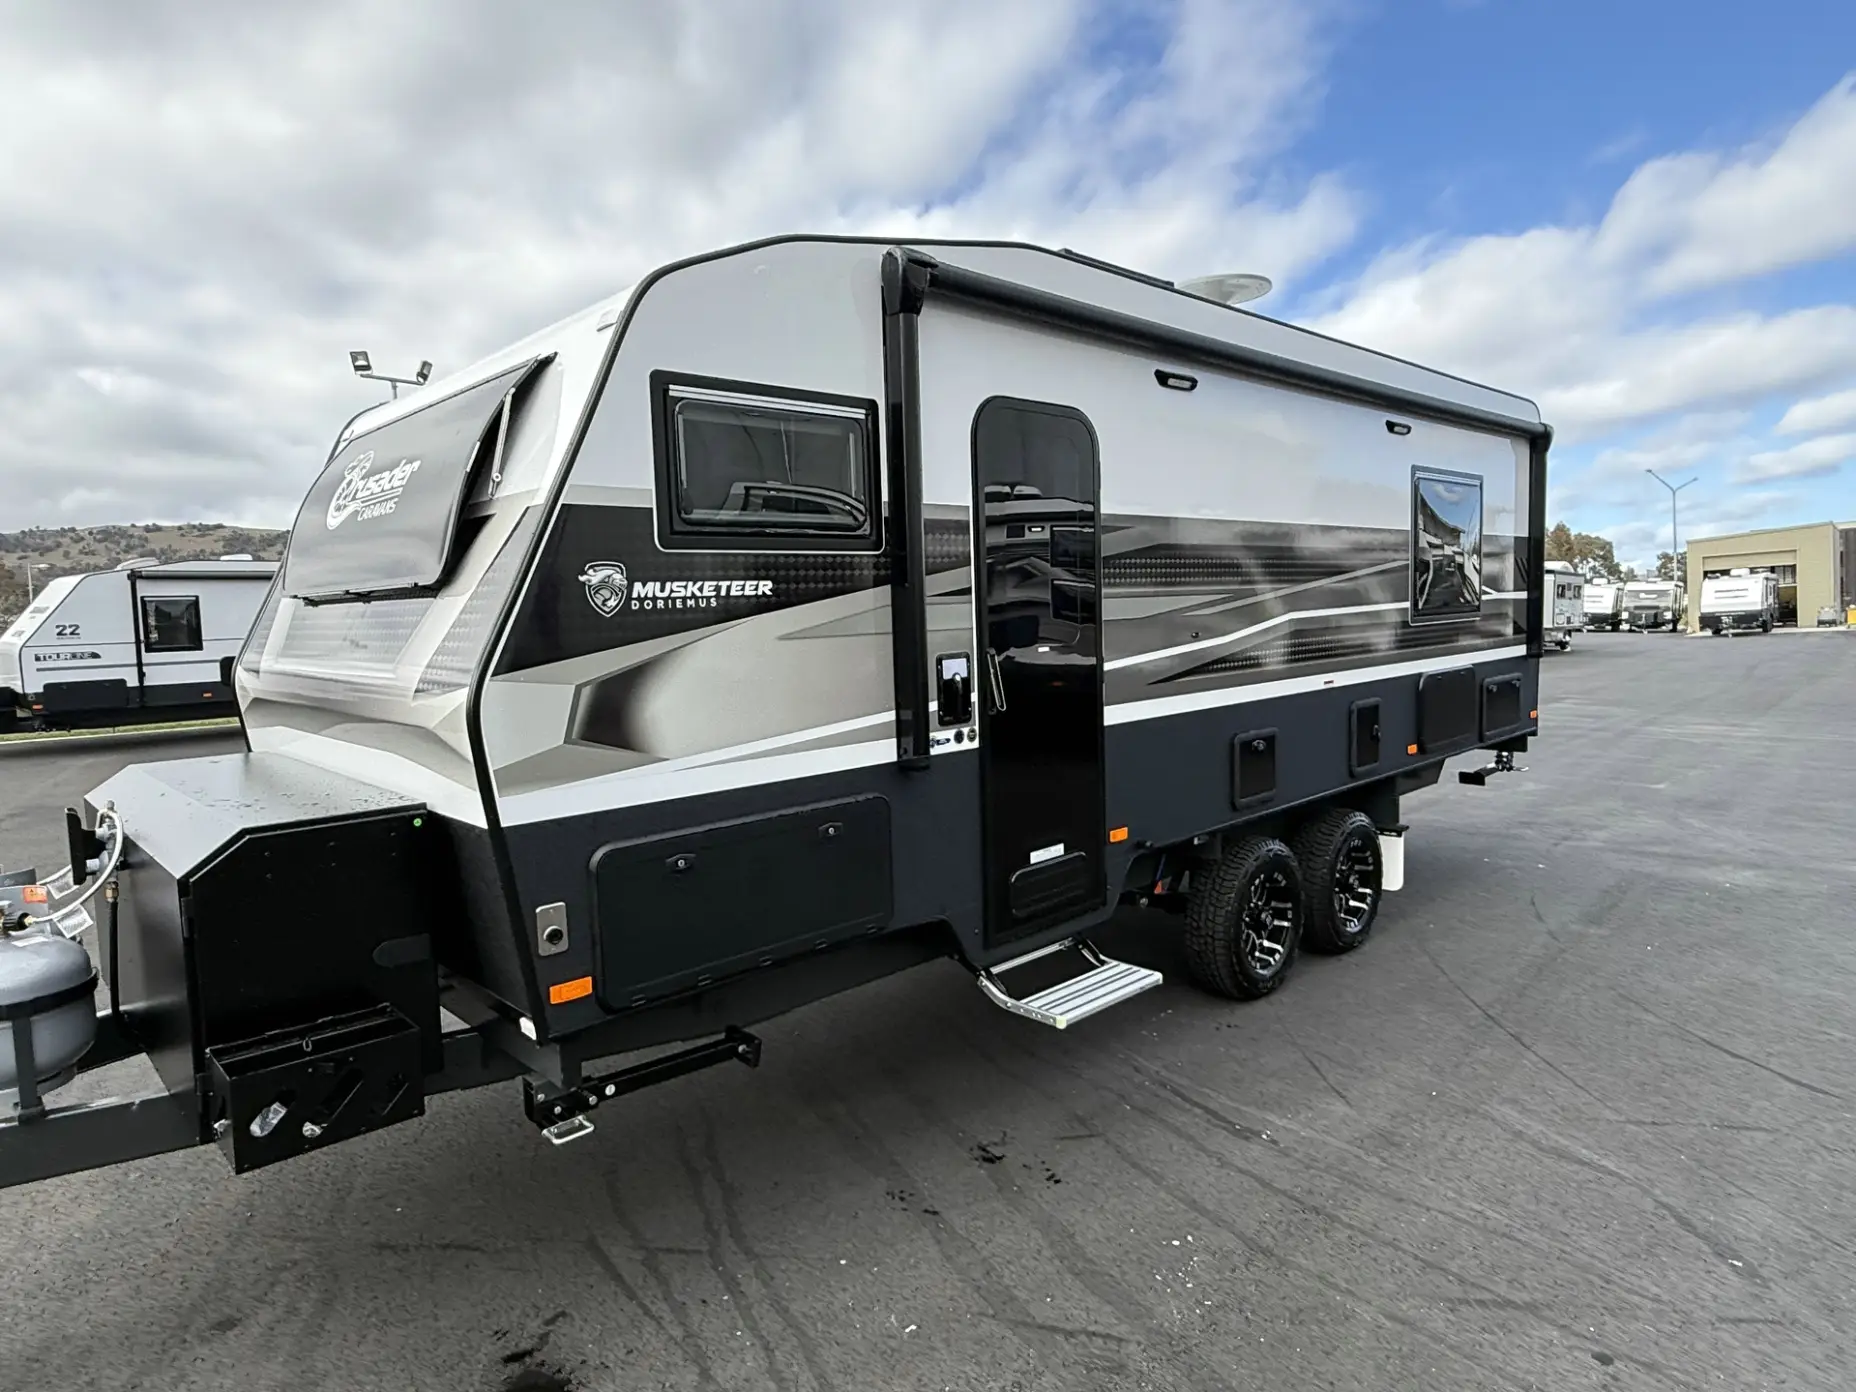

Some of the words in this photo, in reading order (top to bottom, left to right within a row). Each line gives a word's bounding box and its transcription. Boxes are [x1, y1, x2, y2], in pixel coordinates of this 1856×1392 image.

[632, 580, 773, 598] MUSKETEER
[632, 597, 717, 610] DORIEMUS
[55, 624, 80, 636] 22
